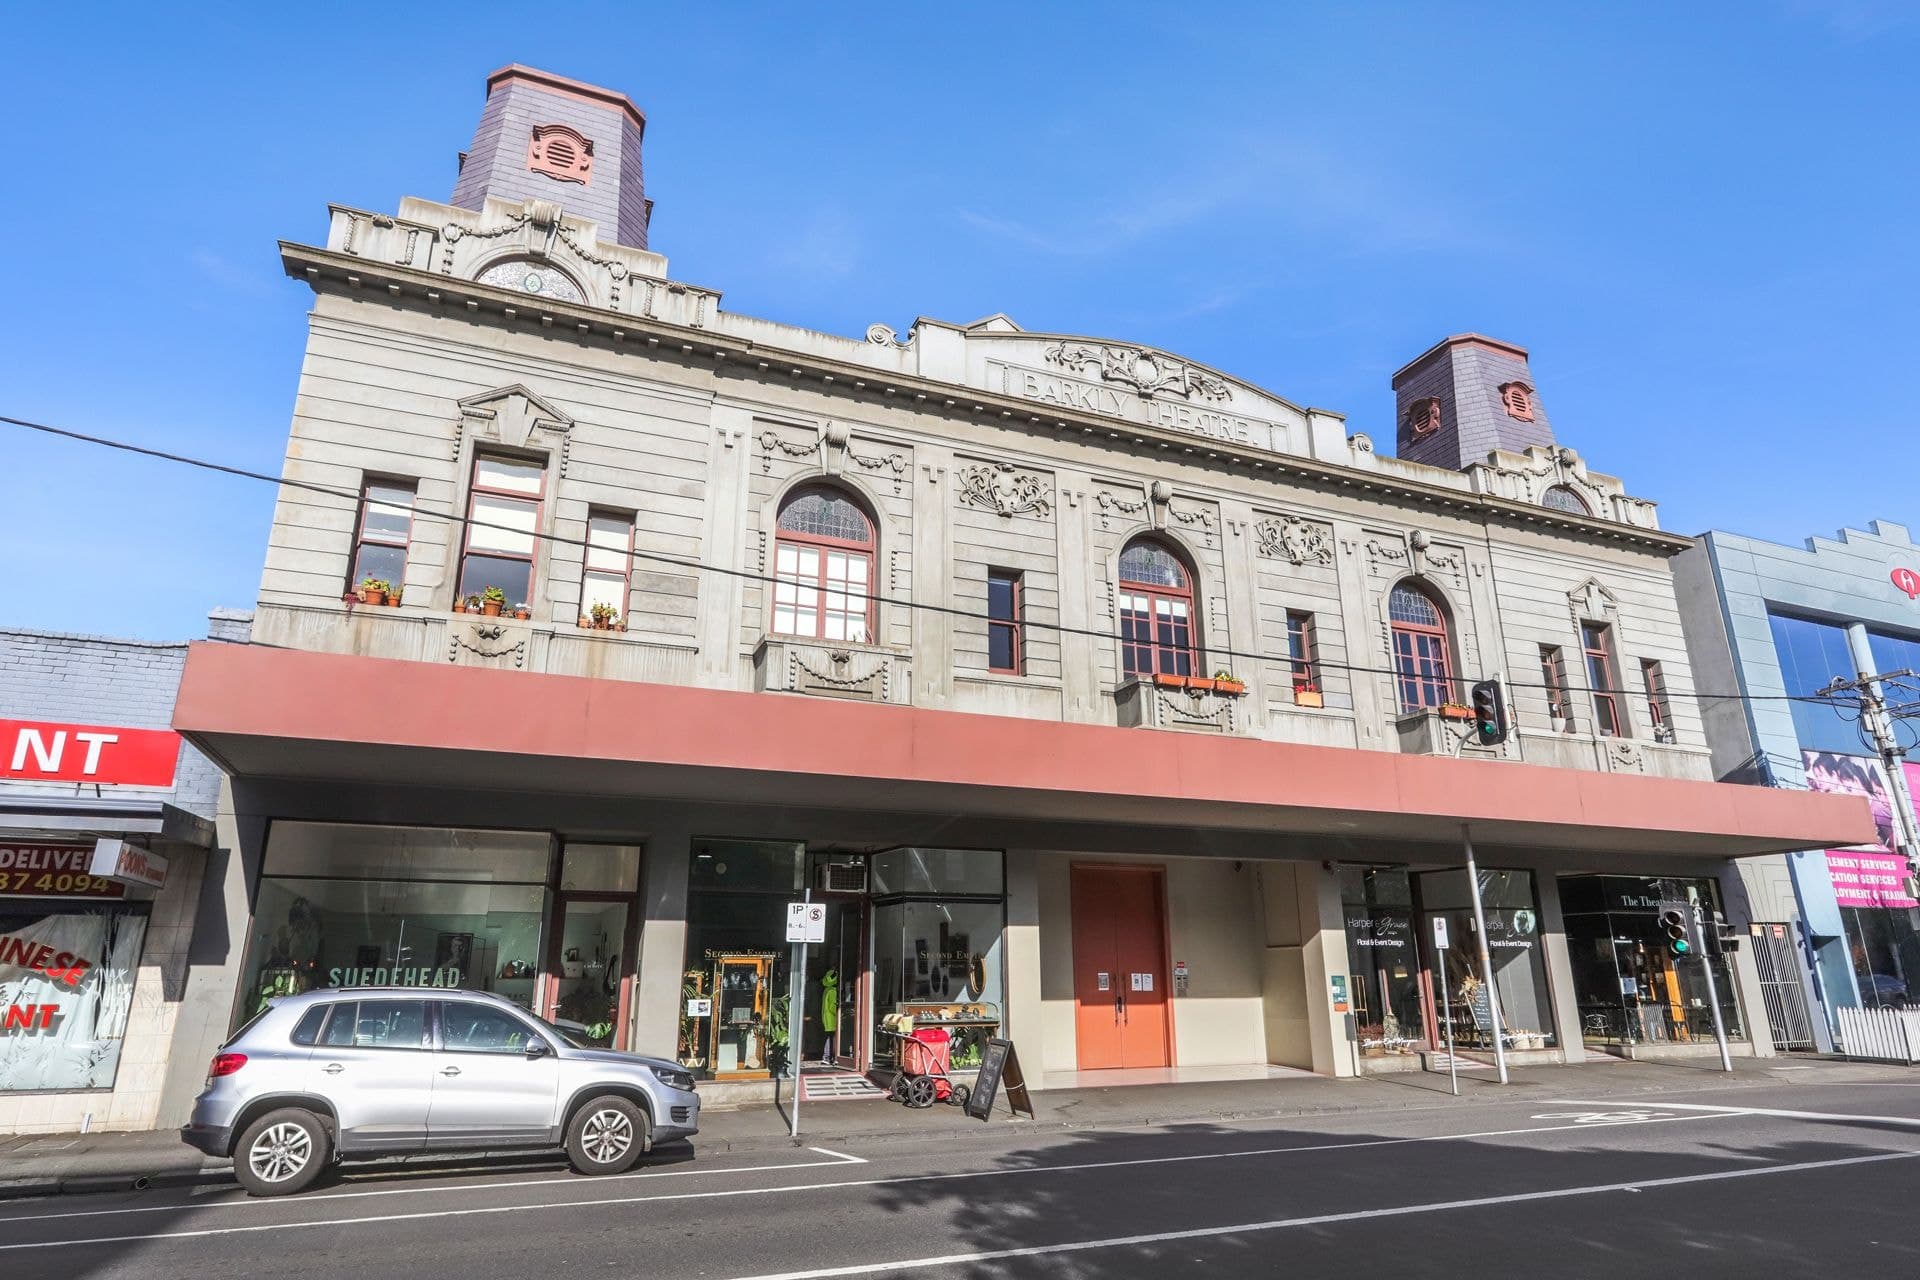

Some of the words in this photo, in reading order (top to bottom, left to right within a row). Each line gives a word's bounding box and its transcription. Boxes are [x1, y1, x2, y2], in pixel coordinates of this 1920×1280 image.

[1023, 372, 1129, 417] BARKLY
[11, 728, 119, 775] NT
[1860, 860, 1896, 870] SERVICES
[34, 872, 110, 892] 4094
[1829, 872, 1859, 883] CATION
[1860, 875, 1896, 885] SERVICES
[1621, 896, 1638, 906] The
[1639, 896, 1665, 907] Theat
[792, 905, 804, 914] 1P
[1347, 918, 1374, 929] Harper
[705, 948, 742, 958] SECOND
[920, 950, 953, 959] SECOND
[328, 967, 461, 988] SUEDEHEAD
